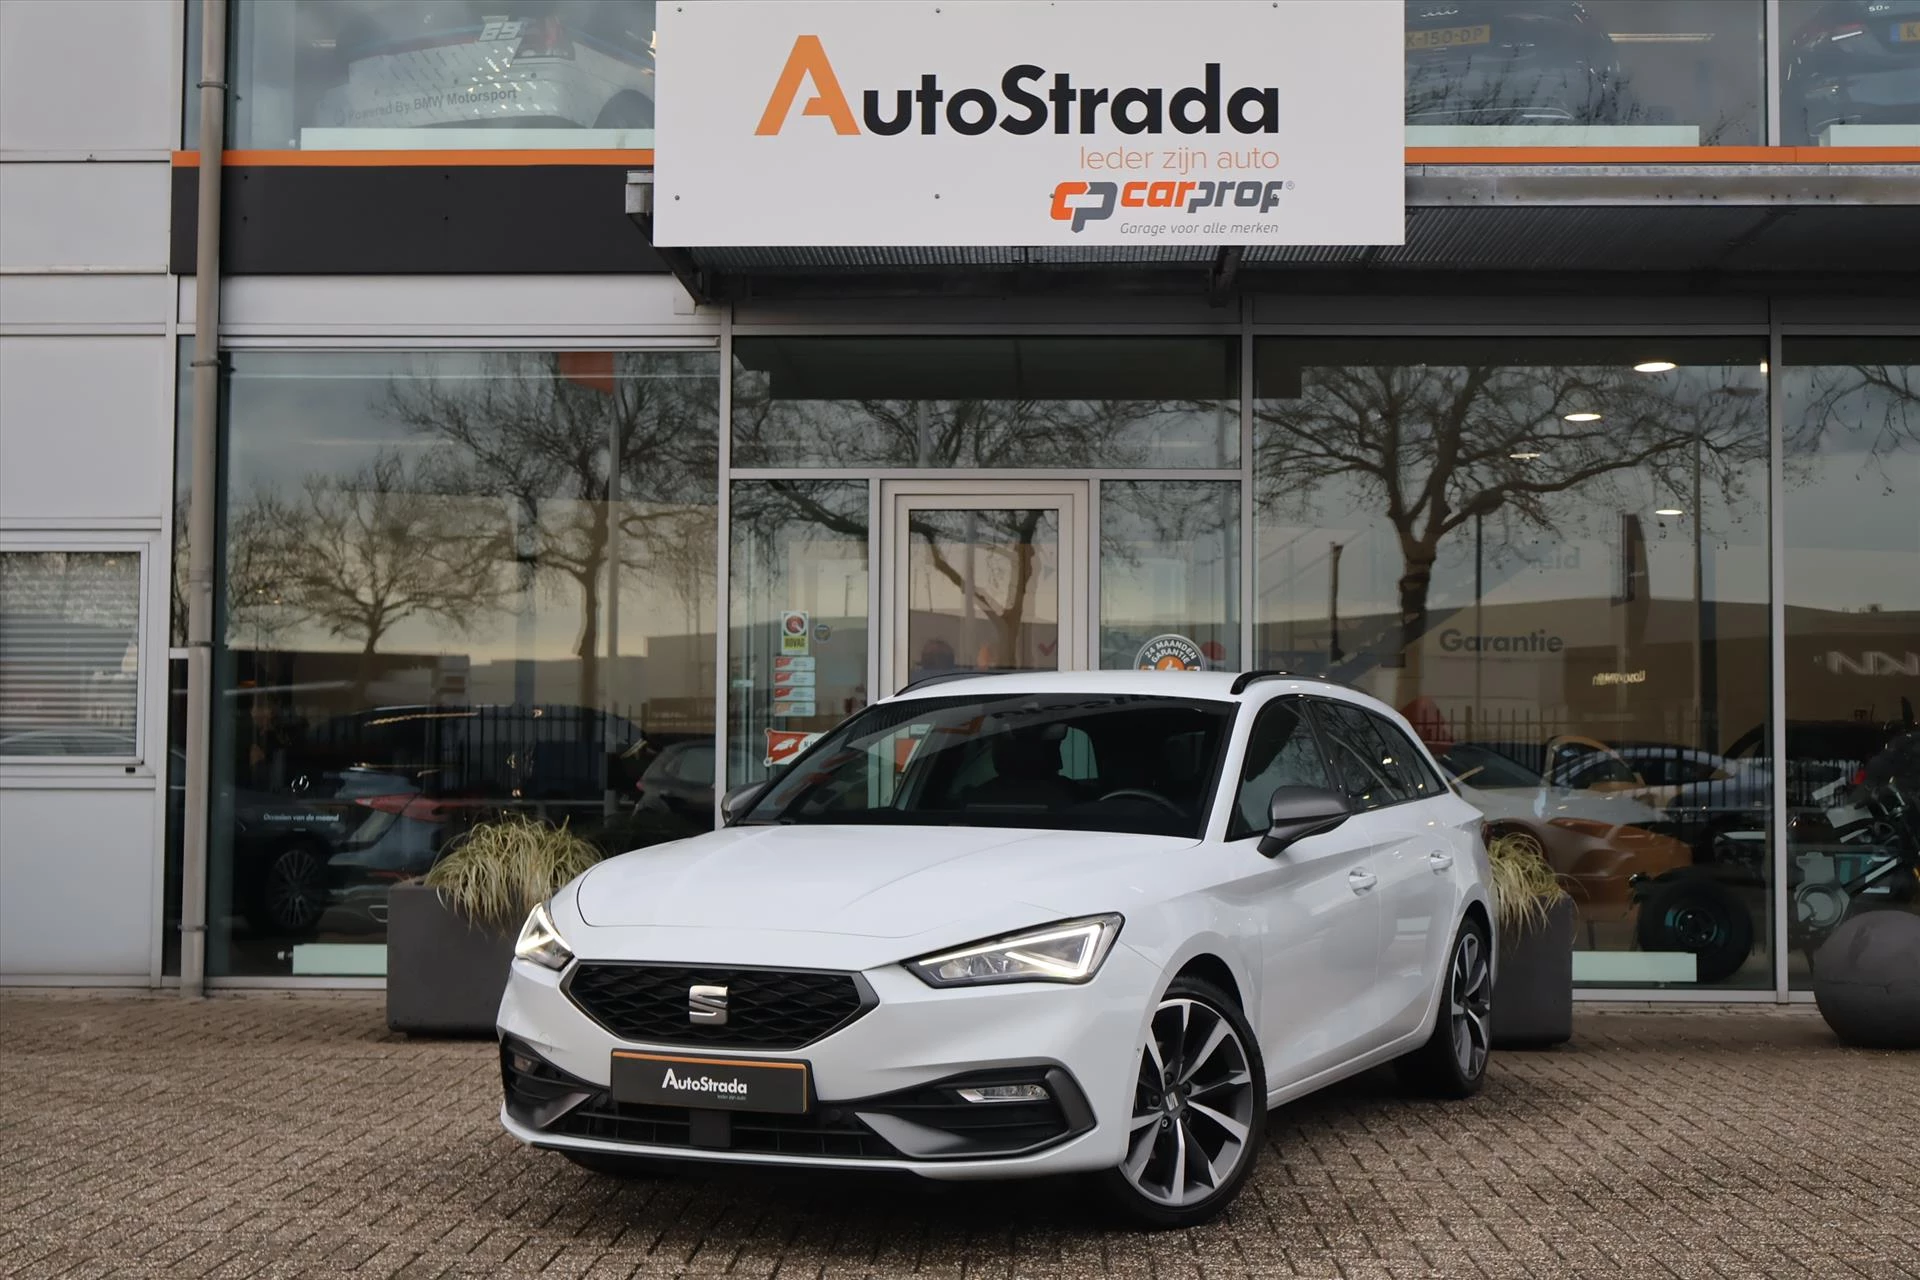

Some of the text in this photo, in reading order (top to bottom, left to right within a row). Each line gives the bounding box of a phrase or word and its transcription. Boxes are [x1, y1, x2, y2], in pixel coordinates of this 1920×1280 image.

[754, 35, 1279, 136] AutoStrada
[394, 101, 411, 114] By
[414, 95, 444, 111] BMW
[447, 87, 518, 106] Motorsport
[1080, 146, 1280, 175] Ieder zijn auto
[1120, 221, 1279, 236] Garage voor alle merken
[1145, 640, 1197, 660] 24 MAANDEN
[1439, 628, 1564, 653] Garantie
[1151, 647, 1191, 664] GARANTIE
[661, 1068, 748, 1094] AutoStrada
